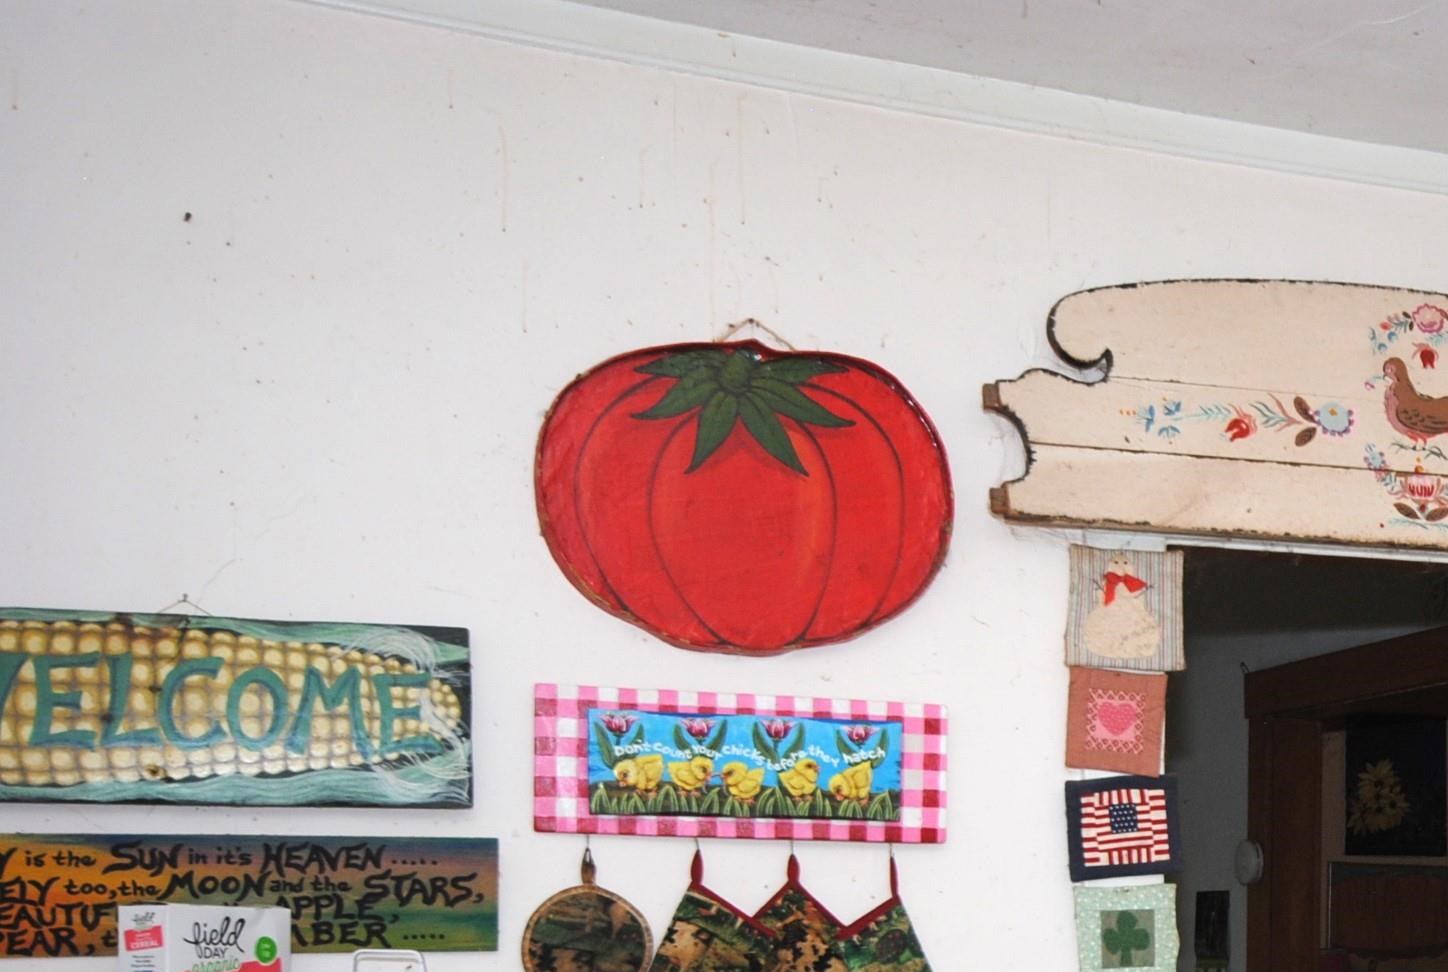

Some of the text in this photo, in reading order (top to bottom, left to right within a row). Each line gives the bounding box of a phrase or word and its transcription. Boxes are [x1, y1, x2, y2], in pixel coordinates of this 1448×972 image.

[842, 746, 886, 764] hatch
[25, 850, 48, 868] is
[52, 850, 97, 869] the
[102, 840, 186, 878] SUN
[188, 849, 209, 865] in
[260, 841, 387, 878] HEAVEN
[63, 879, 117, 900] too,
[117, 879, 161, 898] the
[157, 870, 273, 902] MOON
[270, 876, 305, 893] and
[310, 875, 352, 893] the
[362, 868, 485, 908] STARS,
[183, 915, 246, 959] field
[203, 946, 230, 960] DAY
